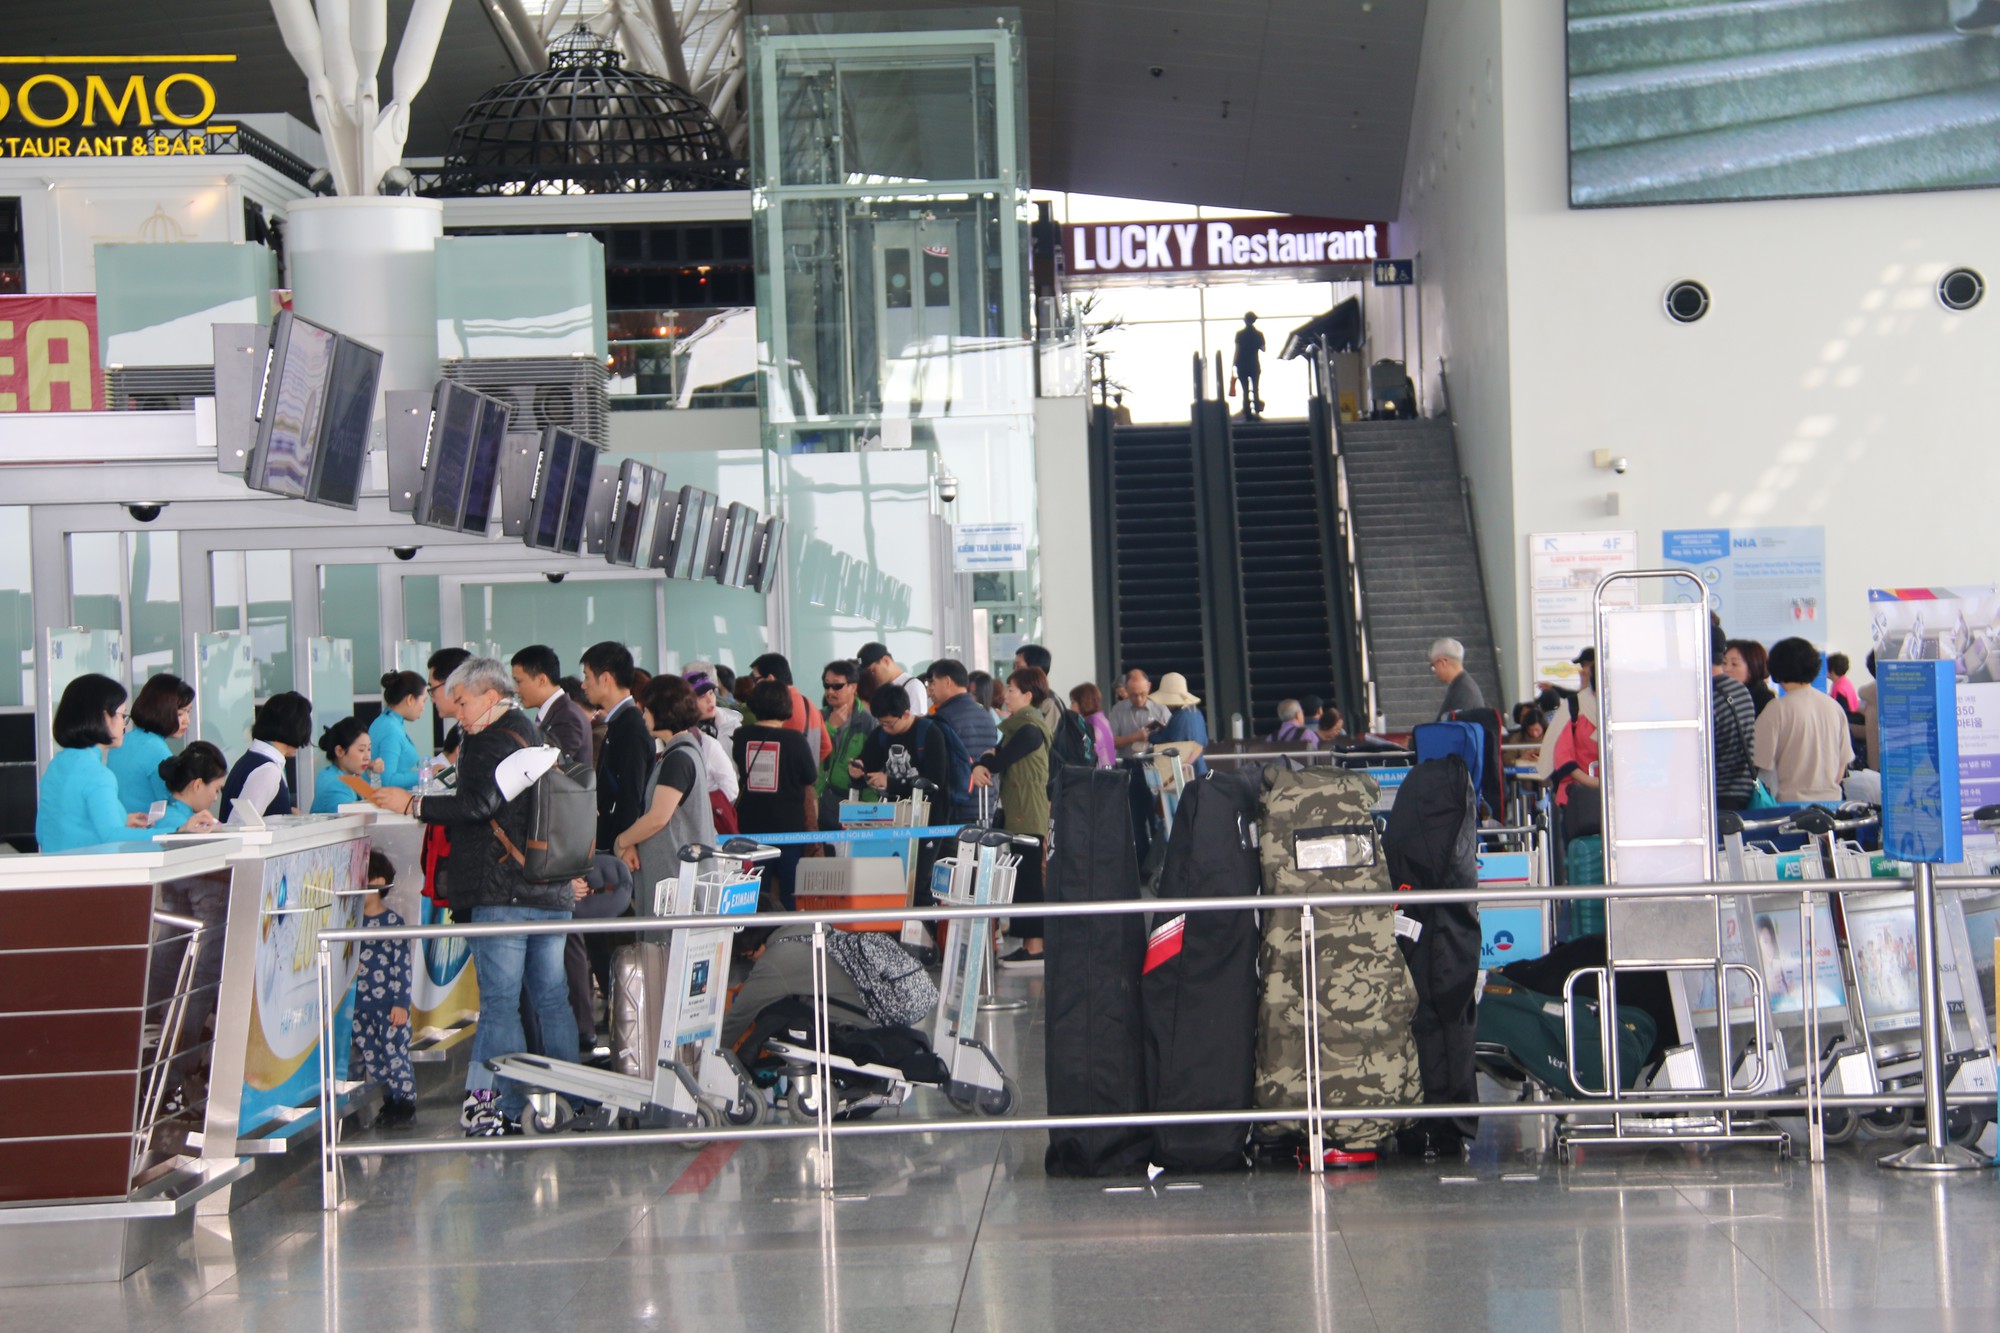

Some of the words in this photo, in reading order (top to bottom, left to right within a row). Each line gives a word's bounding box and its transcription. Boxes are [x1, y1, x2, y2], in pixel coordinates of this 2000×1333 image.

[131, 136, 148, 156] &
[154, 135, 206, 156] BAR
[1073, 223, 1198, 270] LUCKY
[1206, 221, 1378, 265] Restaurant
[1603, 537, 1621, 549] 4F
[1733, 537, 1757, 548] NIA
[731, 890, 757, 908] EXIMBANK
[663, 1039, 672, 1048] T2
[1973, 1077, 1984, 1087] T2
